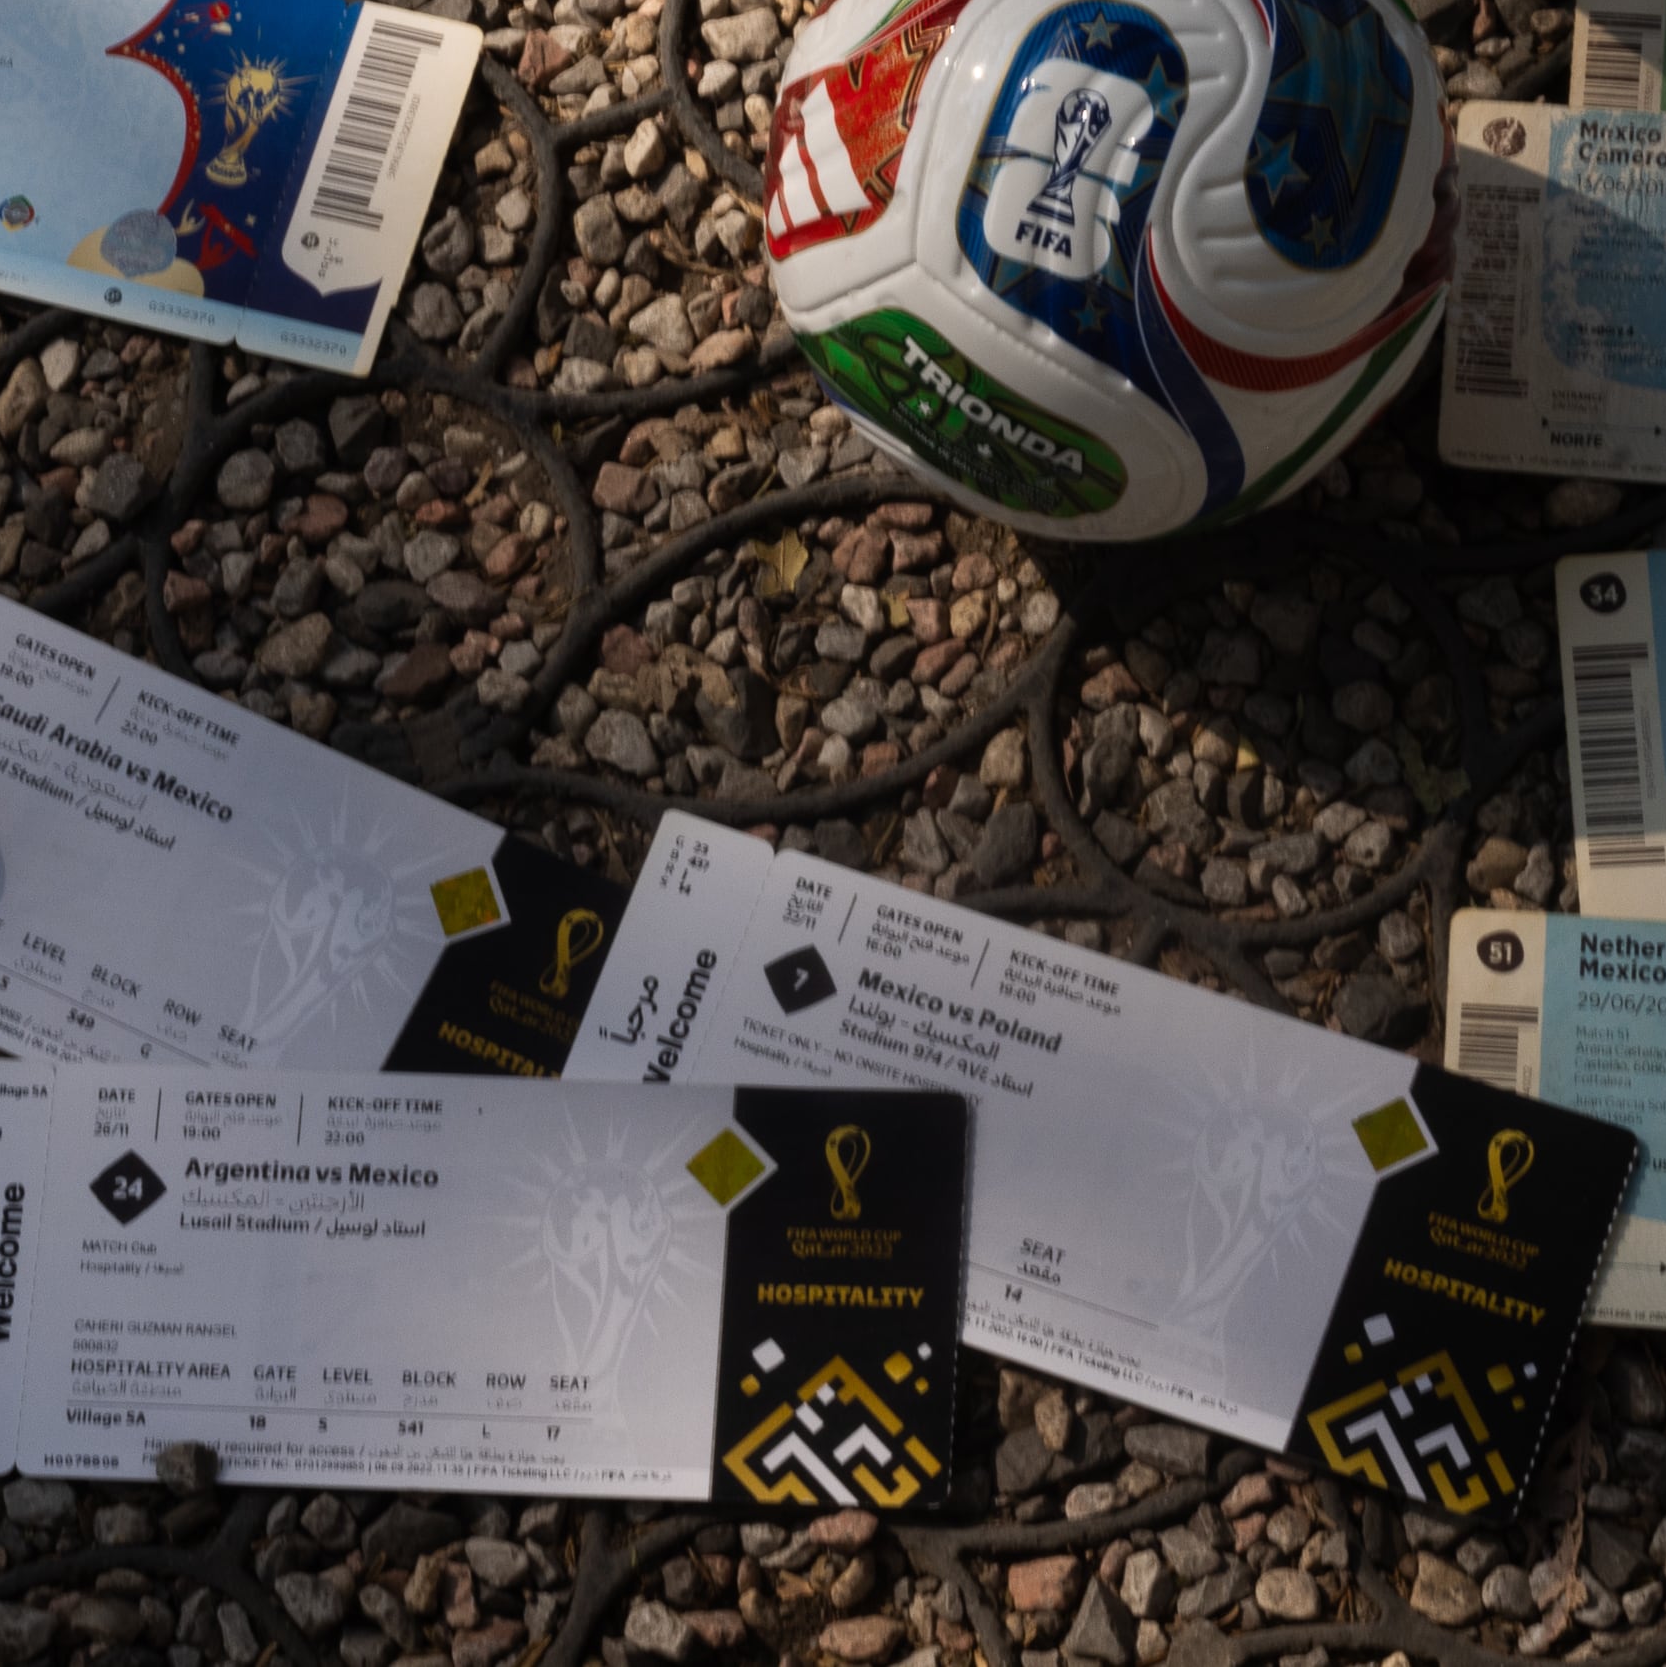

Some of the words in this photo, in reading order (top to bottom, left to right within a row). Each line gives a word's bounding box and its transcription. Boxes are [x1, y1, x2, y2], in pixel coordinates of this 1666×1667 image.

[1580, 120, 1662, 145] Mexico
[1014, 222, 1074, 260] FIFA
[902, 334, 1084, 476] TRIONDA
[1549, 432, 1603, 449] NORTE
[15, 633, 59, 665] GATES
[58, 655, 97, 680] OPEN
[137, 689, 204, 728] KICK-OFF
[205, 719, 241, 749] TIME
[9, 761, 75, 807] Stadium
[48, 722, 121, 772] Arabia
[126, 758, 151, 783] vs
[153, 771, 233, 823] Mexico
[796, 876, 833, 899] DATE
[876, 903, 922, 930] GATES
[923, 918, 964, 944] OPEN
[1489, 941, 1513, 965] 51
[1010, 949, 1082, 982] KICK-OFF
[1082, 973, 1121, 996] TIME
[22, 931, 68, 965] LEVEL
[89, 962, 143, 999] BLOCK
[163, 996, 203, 1025] ROW
[218, 1024, 259, 1054] SEAT
[858, 967, 943, 1016] Mexico
[948, 999, 974, 1023] vs
[977, 1008, 1064, 1054] Poland
[839, 1017, 909, 1057] Stadium
[913, 1042, 943, 1065] 974
[98, 1088, 136, 1104] DATE
[185, 1089, 232, 1106] GATES
[233, 1092, 278, 1109] OPEN
[327, 1096, 404, 1114] KICK-OFF
[405, 1098, 444, 1115] TIME
[184, 1156, 311, 1185] Argentina
[315, 1165, 342, 1183] vs
[348, 1163, 439, 1188] Mexico
[112, 1175, 143, 1202] 24
[179, 1212, 232, 1232] Lusail
[235, 1214, 310, 1234] Stadium
[786, 1226, 816, 1241] FIFA
[817, 1227, 870, 1242] WORLD
[82, 1239, 128, 1255] MATCH
[131, 1241, 157, 1255] Club
[1020, 1236, 1066, 1265] SEAT
[80, 1260, 141, 1276] Hospitality
[756, 1281, 925, 1310] HOSPITALITY
[1383, 1255, 1547, 1327] HOSPITALITY
[71, 1359, 184, 1379] HOSPITALITY
[187, 1361, 231, 1380] AREA
[253, 1365, 298, 1381] GATE
[322, 1367, 373, 1385] LEVEL
[402, 1370, 457, 1387] BLOCK
[485, 1373, 527, 1390] ROW
[549, 1375, 590, 1391] SEAT
[66, 1410, 123, 1428] Village
[248, 1416, 267, 1432] 18
[397, 1420, 424, 1436] 541
[546, 1425, 561, 1442] 17
[224, 1440, 281, 1458] required
